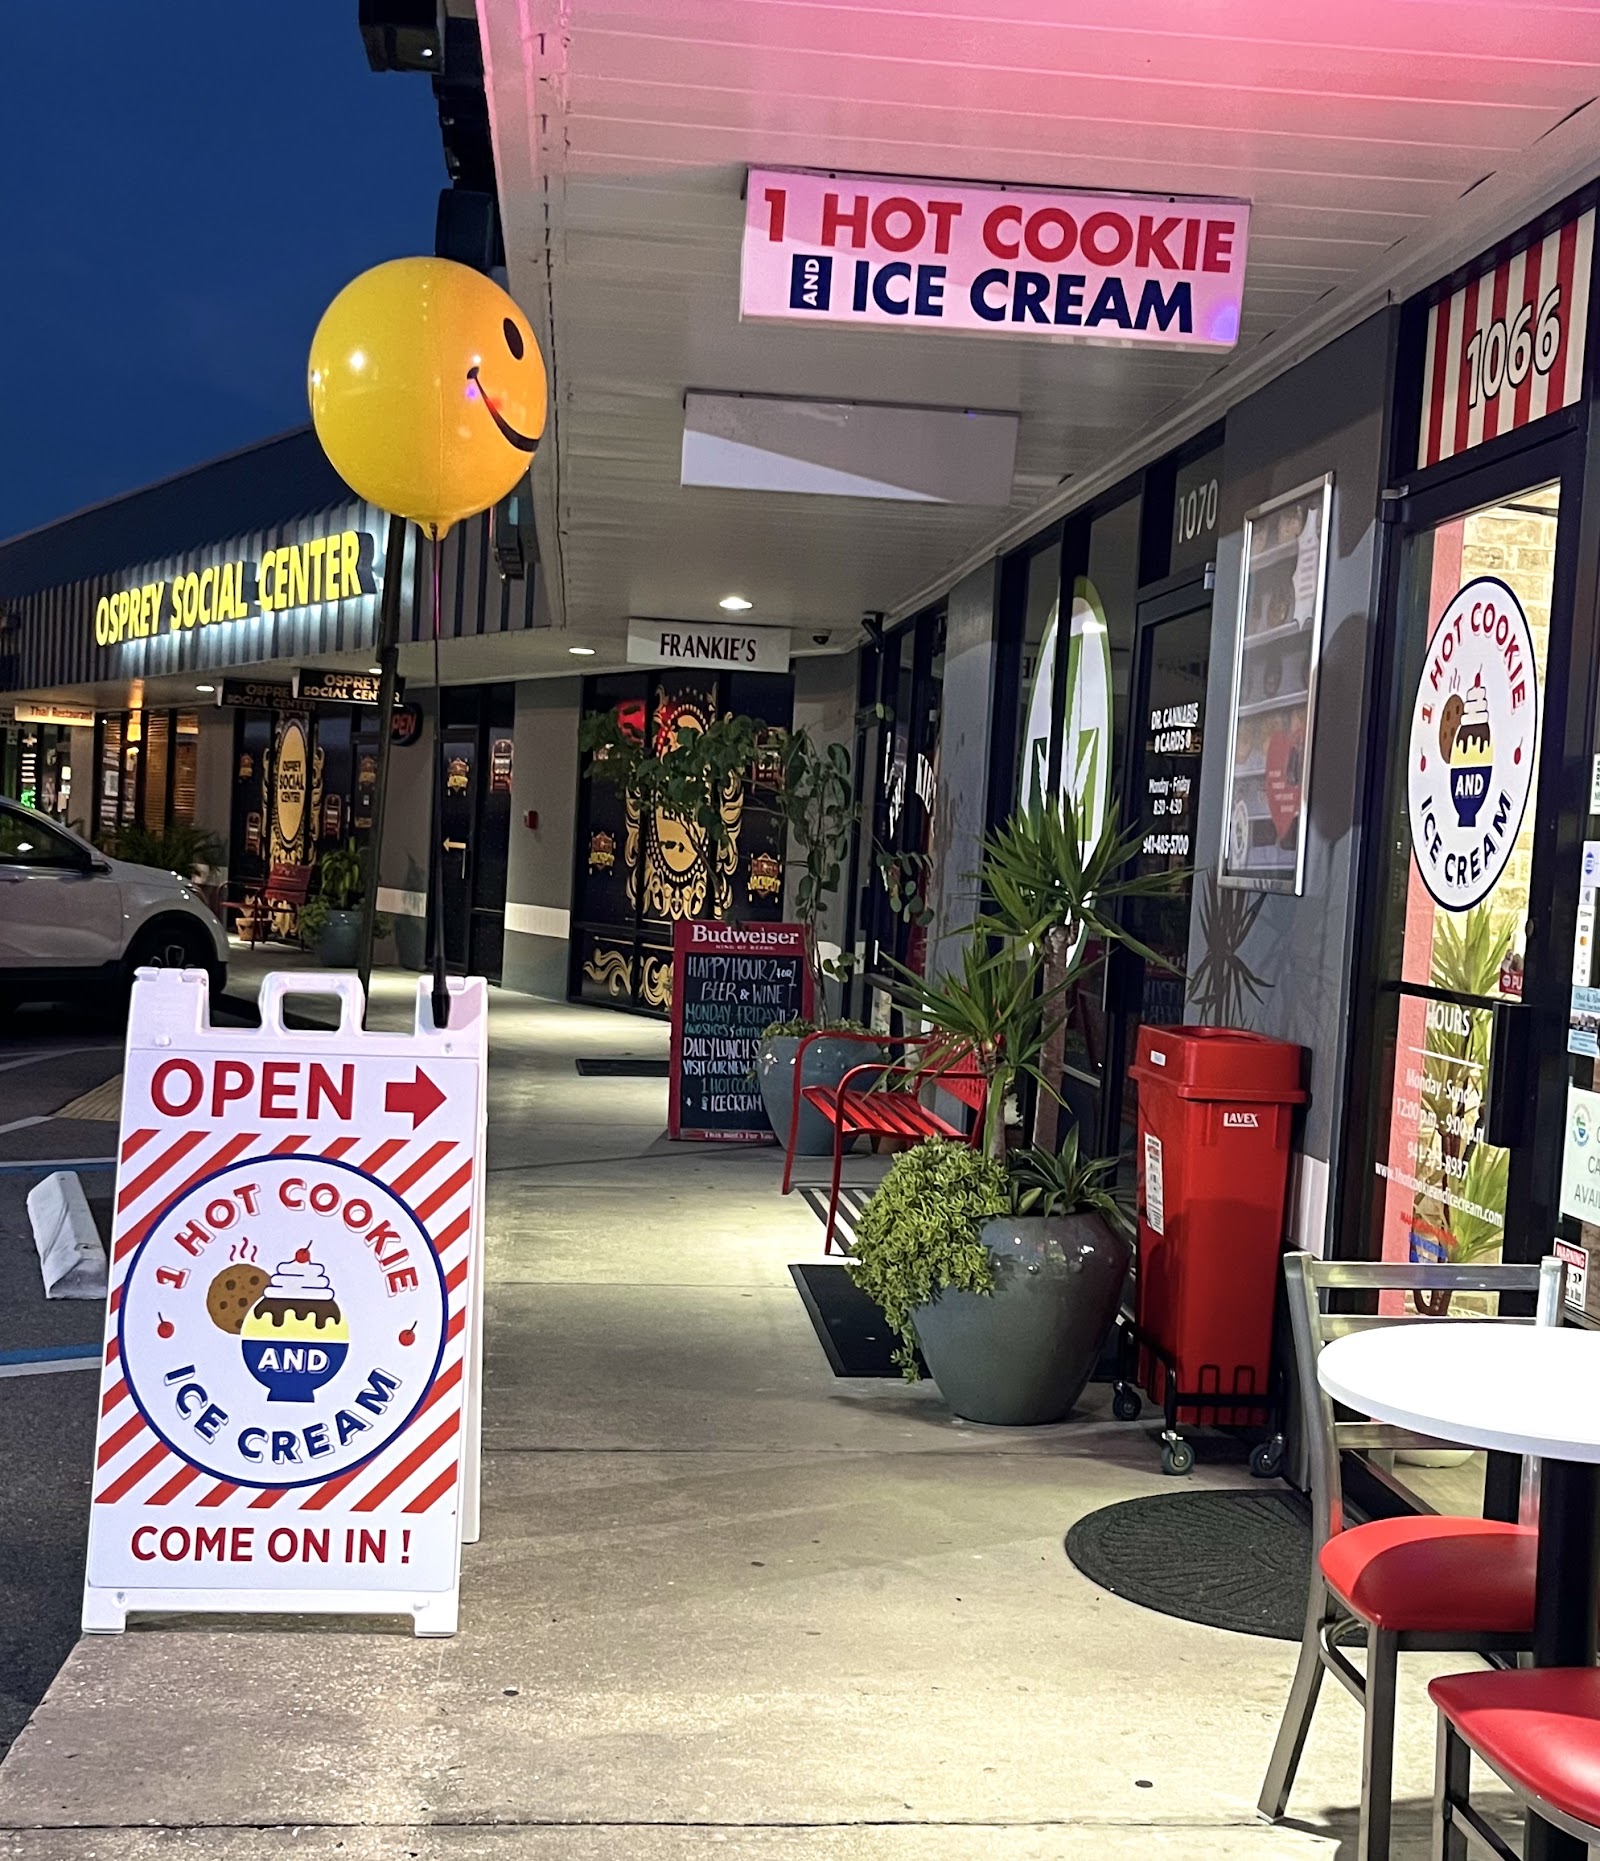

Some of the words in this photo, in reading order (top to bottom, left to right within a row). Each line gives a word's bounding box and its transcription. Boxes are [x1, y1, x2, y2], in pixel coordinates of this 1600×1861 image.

[765, 189, 786, 242] 1
[821, 192, 962, 254] HOT
[982, 204, 1235, 273] COOKIE
[802, 258, 819, 305] AND
[853, 260, 947, 317] ICE
[970, 268, 1194, 333] CREAM
[1466, 283, 1562, 409] 1066
[1179, 479, 1218, 544] 1070
[95, 581, 165, 646] OSPREY
[170, 561, 248, 631] SOCIAL
[258, 530, 363, 612] CENTER
[659, 632, 757, 663] FRANKIE'S
[1429, 613, 1465, 692] HOT
[1470, 602, 1527, 715] COOKIE
[245, 684, 291, 698] OSPRE
[304, 686, 349, 700] SOCIAL
[324, 674, 381, 690] OSPREY
[393, 712, 417, 737] PEN
[1454, 773, 1484, 799] AND
[1419, 795, 1443, 866] ICE
[1443, 788, 1513, 887] CREAM
[691, 924, 800, 945] Budweiser
[687, 956, 731, 982] HAPPY
[731, 957, 768, 982] HOUR
[701, 980, 739, 1005] BEER
[752, 983, 785, 1004] WINE
[685, 1002, 732, 1023] MONDAY
[737, 1005, 779, 1025] FRIDAY
[1425, 1002, 1471, 1037] HOURS
[683, 1037, 716, 1061] DAILY
[716, 1038, 750, 1061] LUNCH
[683, 1060, 707, 1077] VISIT
[707, 1060, 728, 1076] OUR
[728, 1060, 750, 1076] NEW
[150, 1057, 355, 1121] OPEN
[710, 1078, 731, 1094] HOT
[1405, 1068, 1442, 1102] Monday
[1223, 1112, 1259, 1128] LAVEX
[156, 1264, 189, 1291] 1
[173, 1183, 261, 1258] HOT
[277, 1177, 419, 1298] COOKIE
[257, 1347, 330, 1374] AND
[163, 1363, 228, 1444] ICE
[236, 1367, 402, 1465] CREAM
[131, 1525, 253, 1562] COME
[267, 1528, 330, 1563] ON
